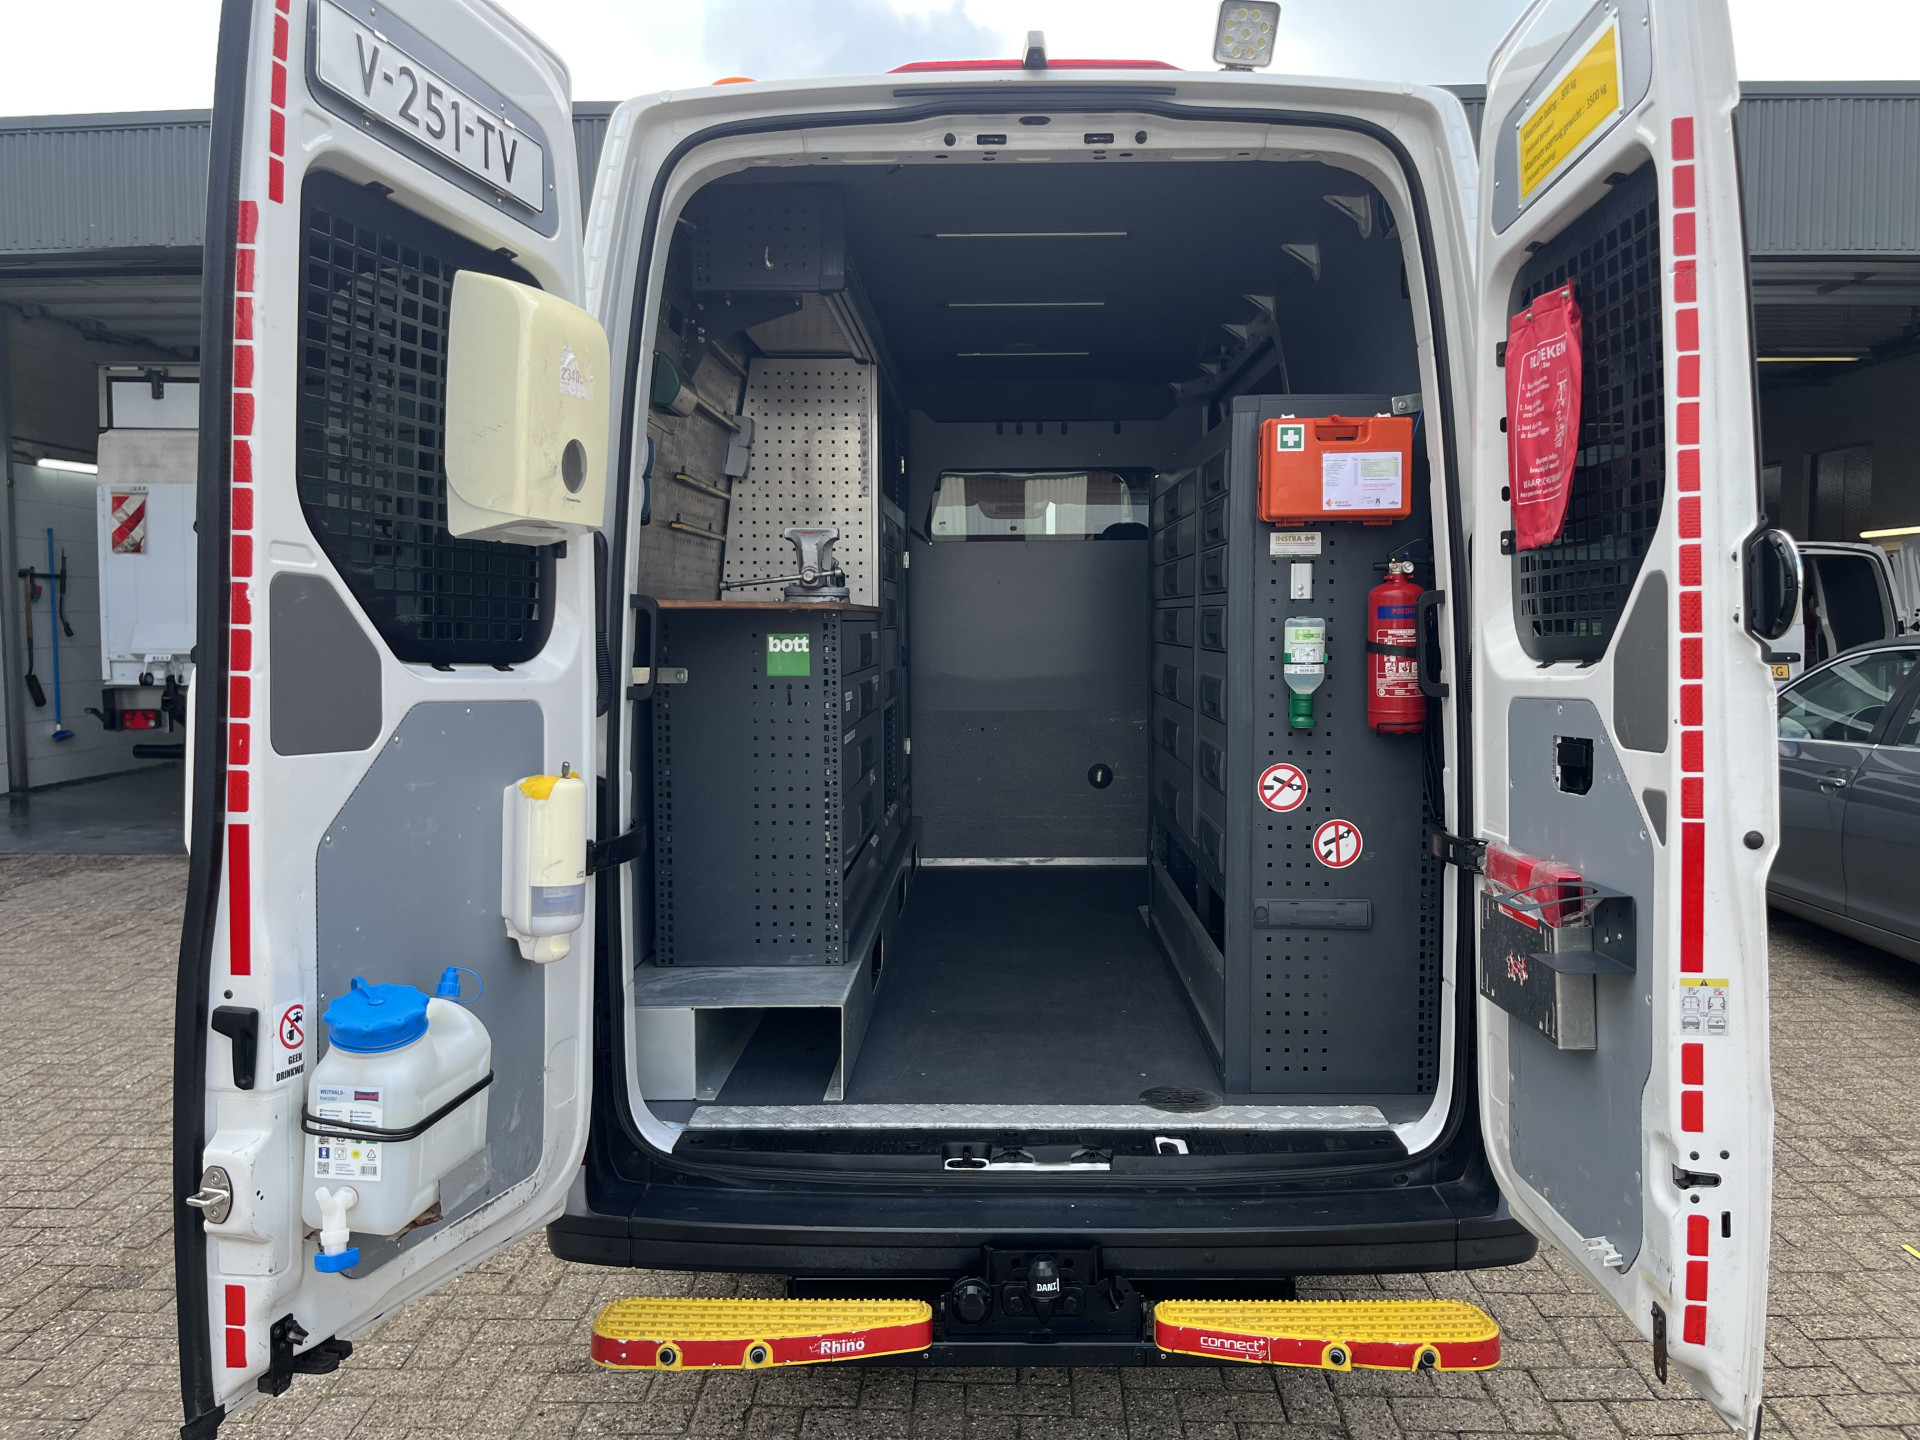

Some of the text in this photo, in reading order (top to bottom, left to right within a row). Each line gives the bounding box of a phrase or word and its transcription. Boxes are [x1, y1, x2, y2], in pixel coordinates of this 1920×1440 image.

[356, 33, 518, 183] V-251-TV
[1524, 148, 1544, 174] Maximum
[1586, 89, 1600, 110] 3500
[769, 636, 809, 652] bott
[288, 1052, 302, 1065] GEEN
[820, 1340, 865, 1354] Rhino
